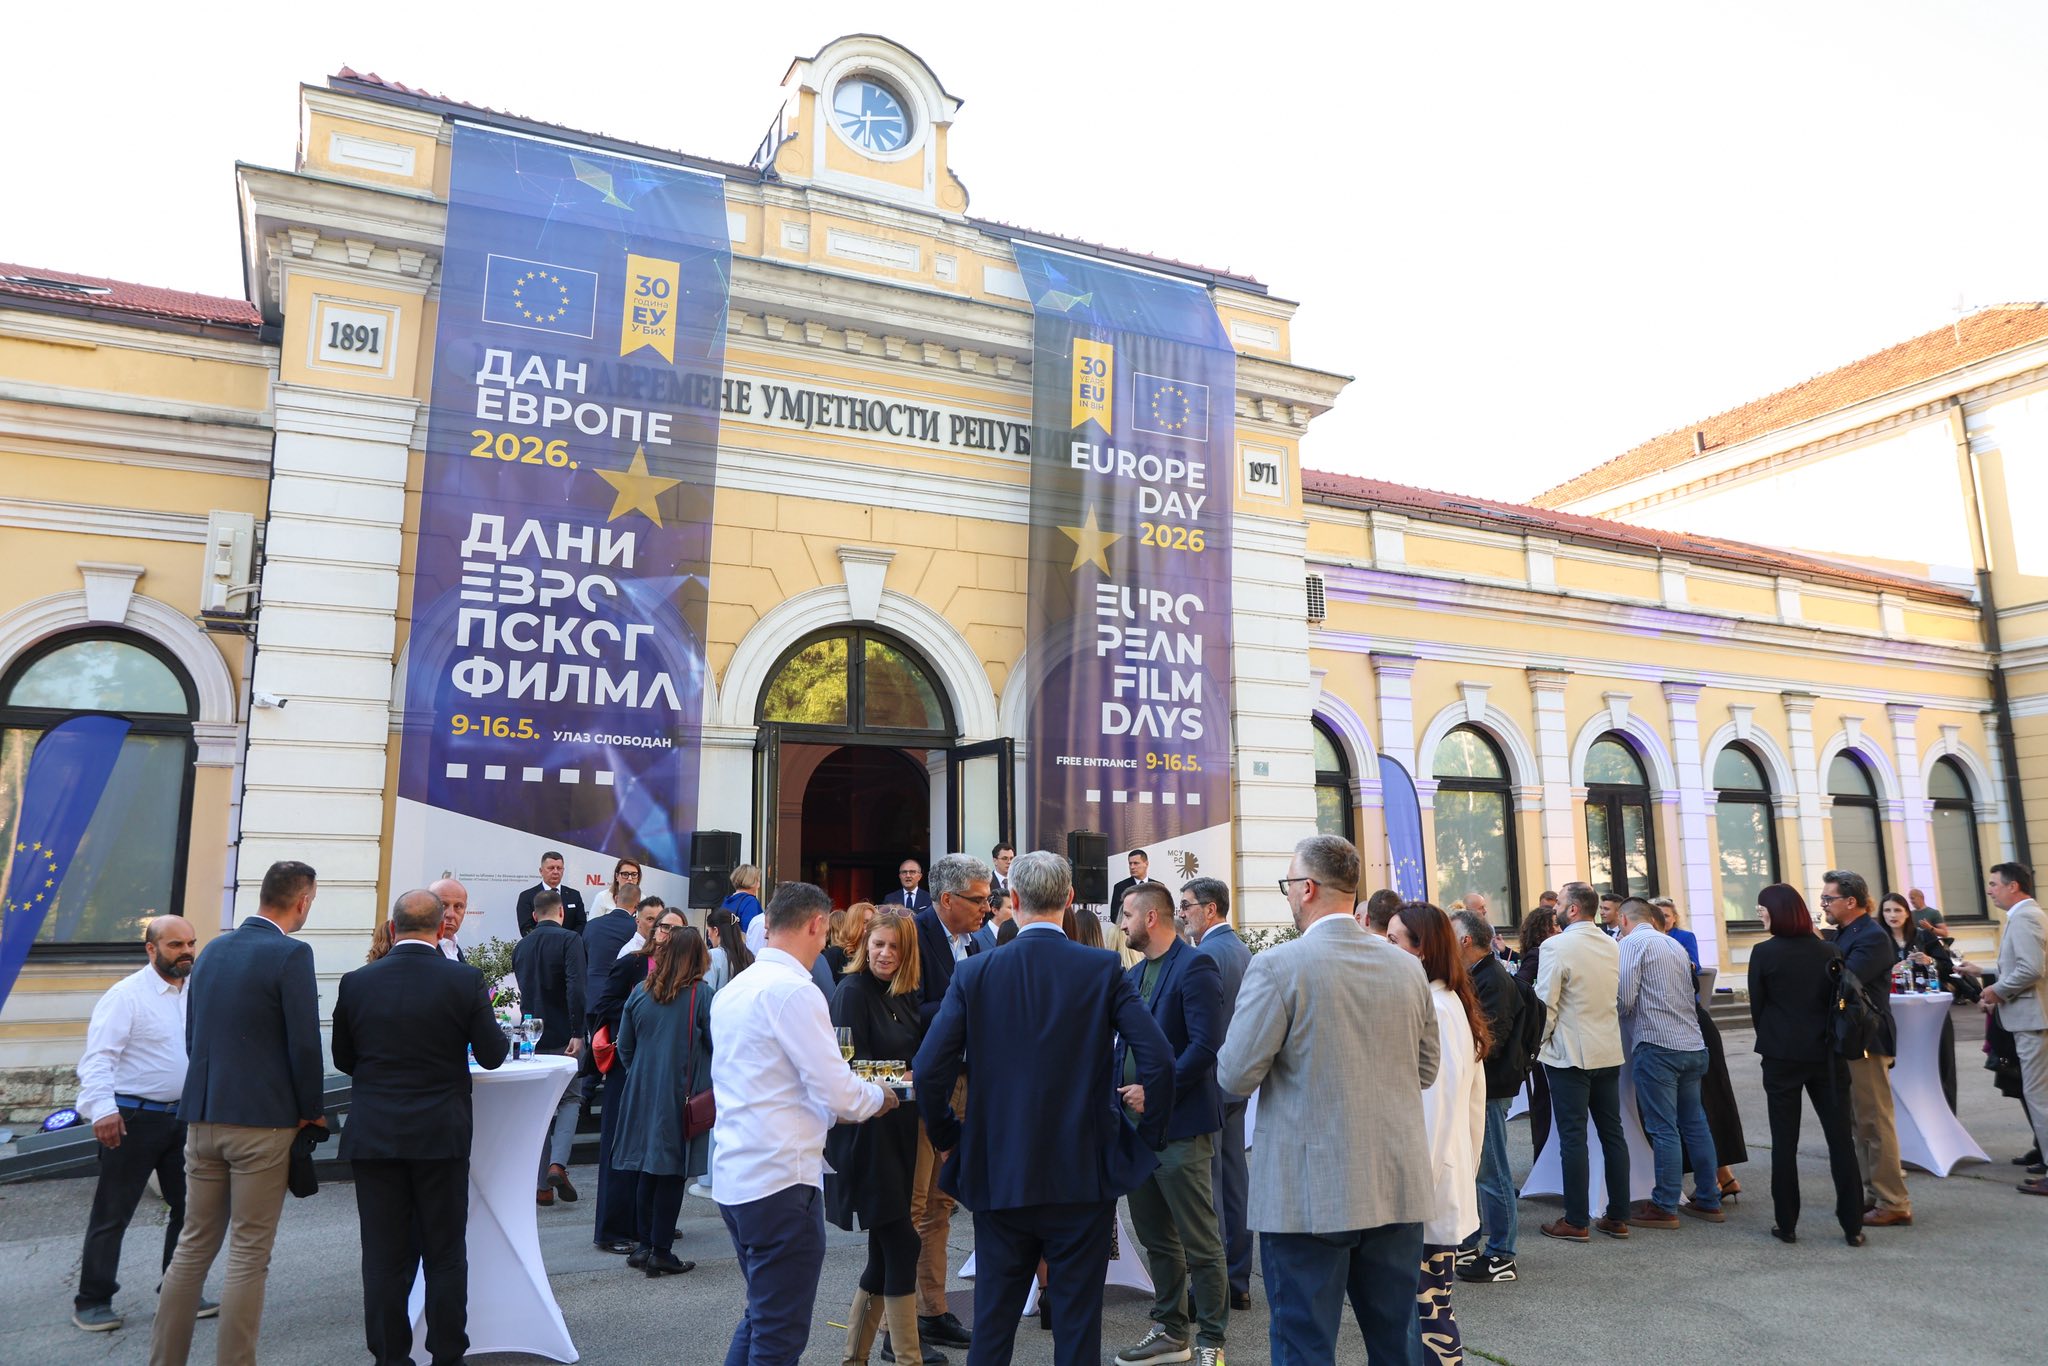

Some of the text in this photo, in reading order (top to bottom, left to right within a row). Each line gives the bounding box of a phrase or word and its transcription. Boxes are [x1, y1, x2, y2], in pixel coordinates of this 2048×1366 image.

[633, 298, 669, 309] година
[634, 274, 670, 299] 30
[632, 305, 667, 326] ЕУ
[643, 326, 666, 337] БиХ
[328, 321, 379, 353] 1891
[475, 348, 587, 394] ДАН
[1080, 355, 1106, 378] 30
[1080, 376, 1105, 387] YEARS
[1080, 383, 1105, 403] EU
[1091, 402, 1104, 411] BIH
[476, 386, 673, 445] ЕВРОПЕ
[761, 384, 940, 442] УМЈЕТНОСТИ
[470, 429, 577, 470] 2026.
[1071, 441, 1206, 489] EUROPE
[1249, 461, 1278, 485] 1971
[1138, 486, 1207, 521] DAY
[460, 512, 636, 569] ДАНИ
[1139, 521, 1205, 553] 2026
[460, 561, 617, 613] ЕВРО
[1096, 583, 1204, 626] EURO
[456, 607, 654, 661] ПСКОГ
[1096, 624, 1202, 666] PEAN
[451, 655, 682, 711] ФИЛМА
[1113, 665, 1202, 704] FILM
[450, 713, 672, 749] 9-16.5. УЛАЗ СЛОБОДАН
[1101, 702, 1204, 740] DAYS
[1056, 752, 1202, 772] FREE ENTRANCE 9-16.5.
[586, 874, 605, 886] NL
